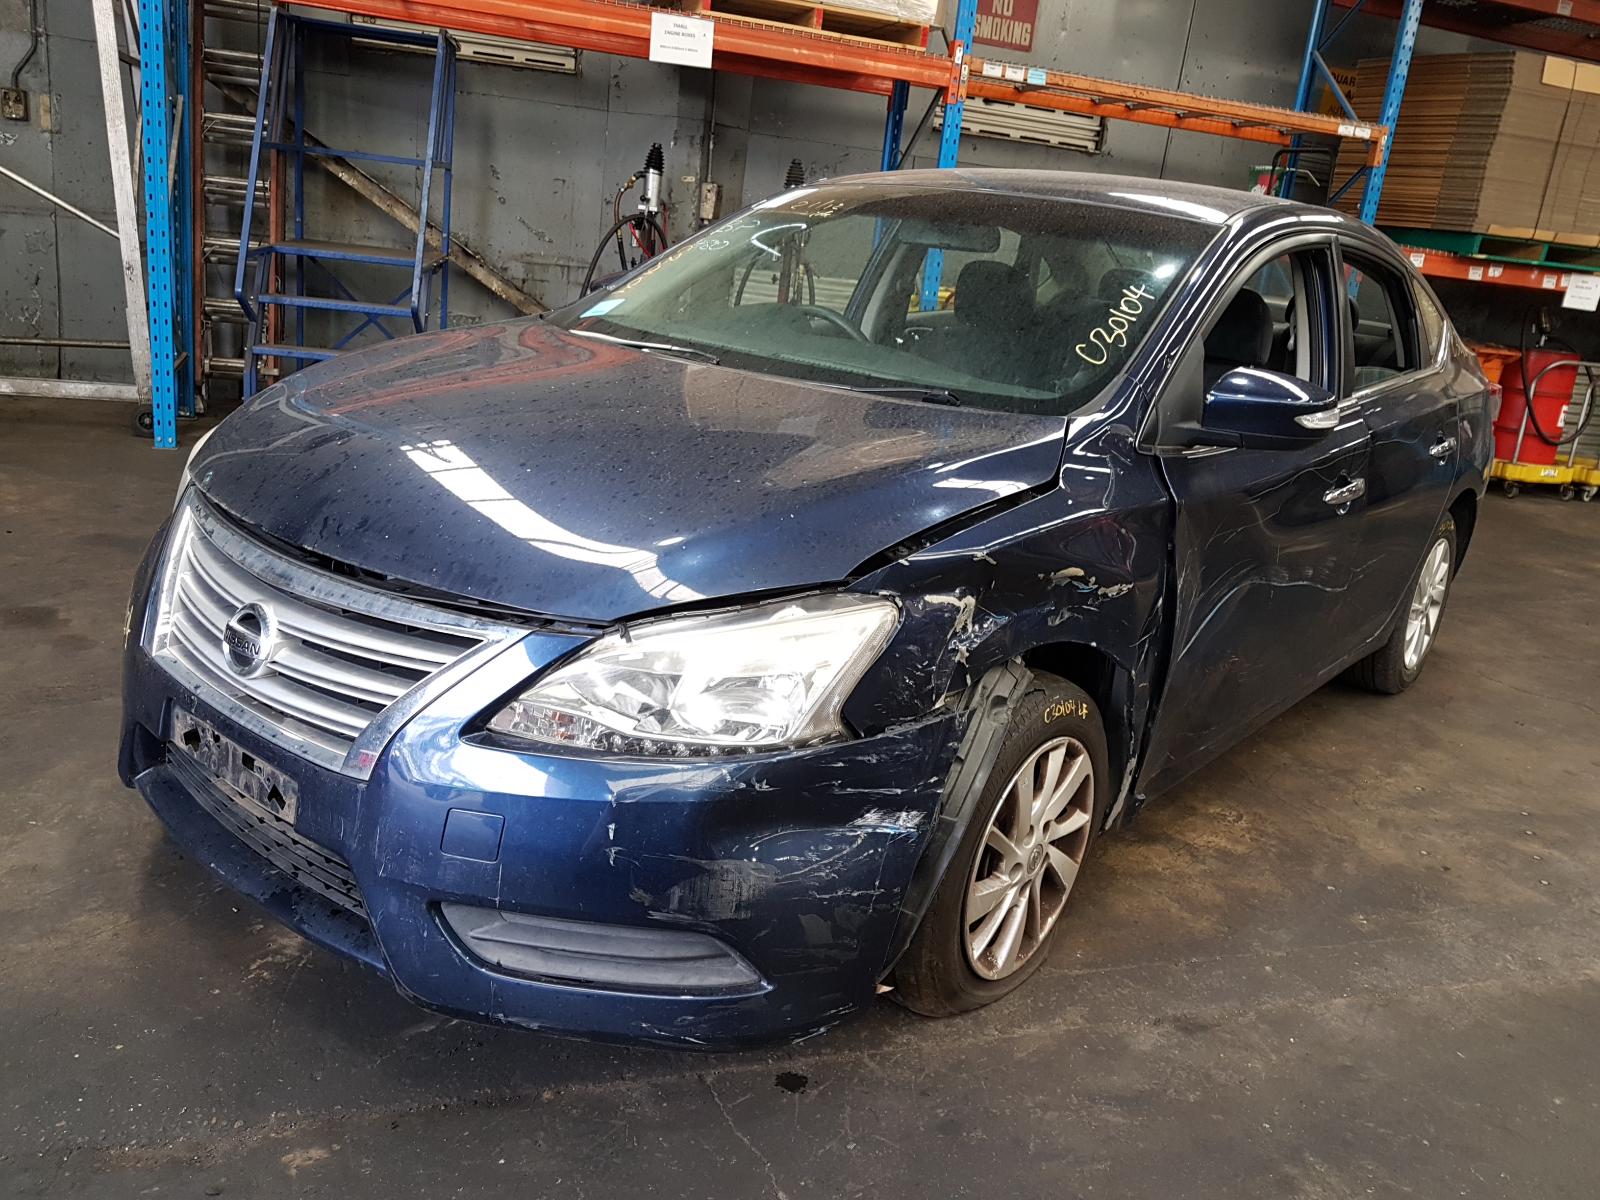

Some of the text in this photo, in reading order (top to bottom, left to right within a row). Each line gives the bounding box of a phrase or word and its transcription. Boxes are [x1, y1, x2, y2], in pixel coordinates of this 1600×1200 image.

[991, 0, 1014, 17] NO
[974, 14, 1033, 47] SMOKING
[1075, 284, 1155, 365] C30104
[225, 628, 261, 656] NISSAN
[1044, 699, 1077, 724] C30104
